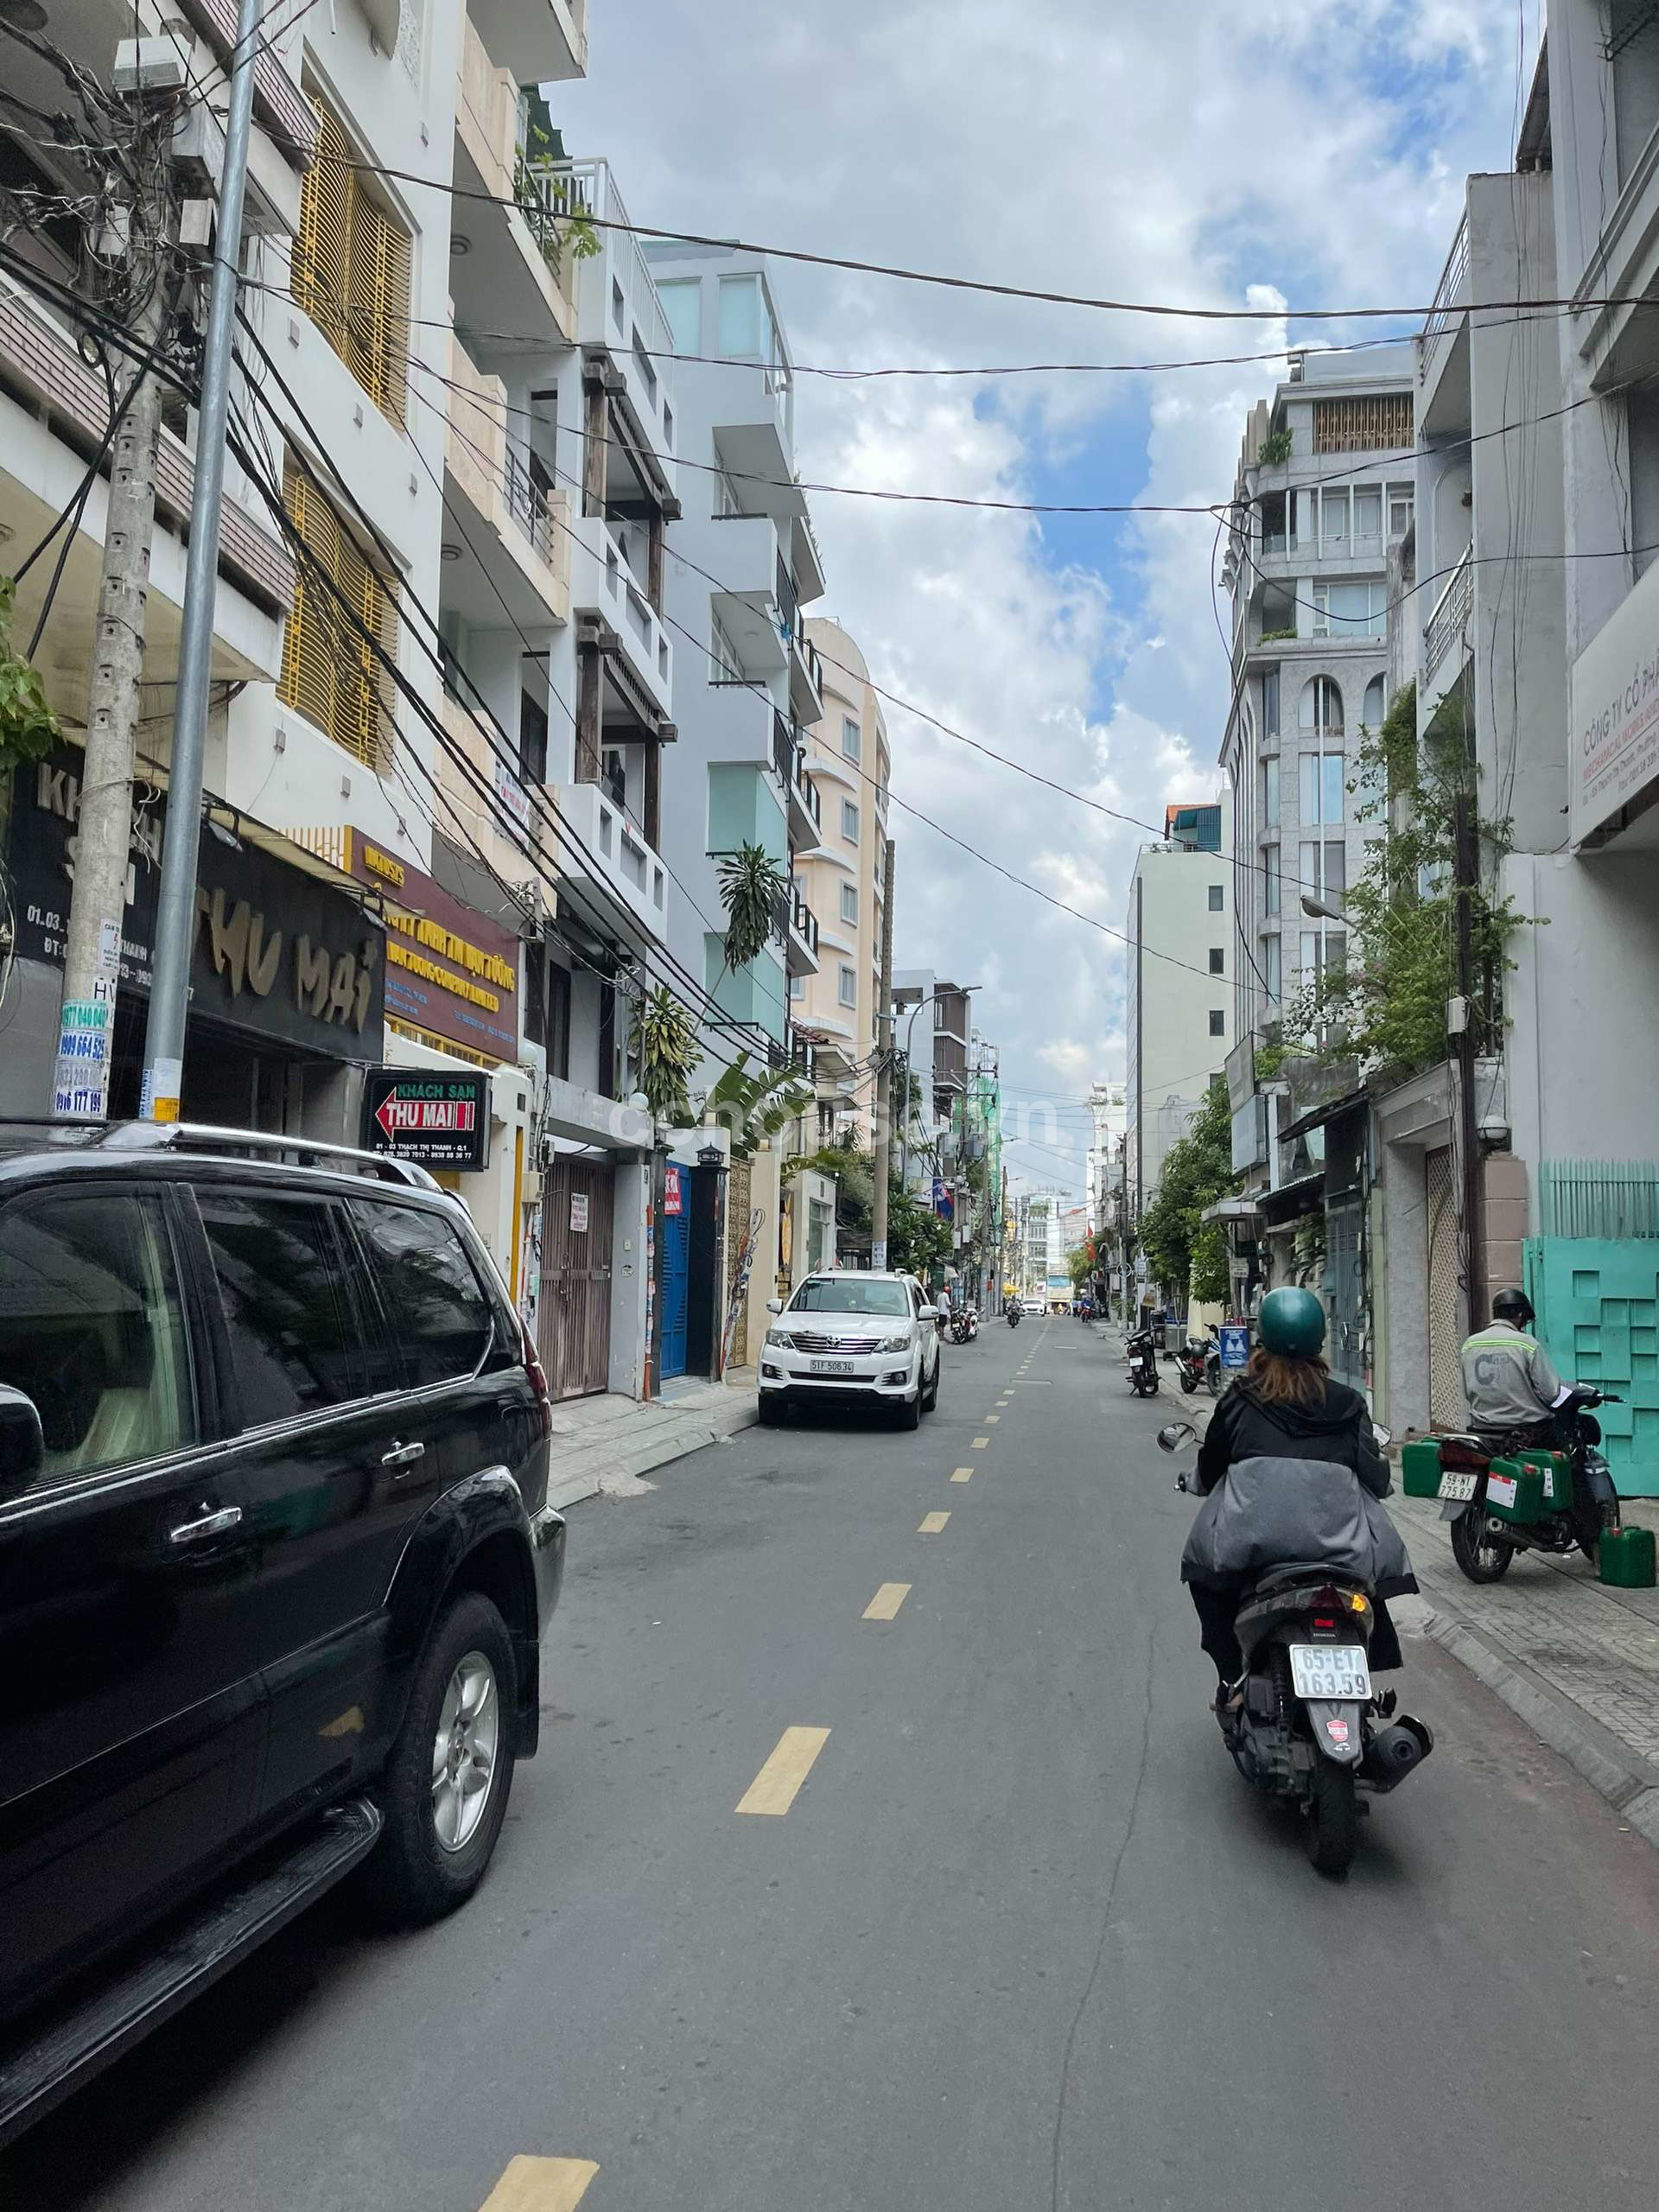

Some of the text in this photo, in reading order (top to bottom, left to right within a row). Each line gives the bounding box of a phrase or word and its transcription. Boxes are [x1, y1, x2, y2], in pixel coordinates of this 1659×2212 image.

[1611, 694, 1623, 728] TY
[74, 1090, 88, 1112] 177
[397, 1082, 475, 1102] KHÁCH SẠN
[386, 1103, 453, 1128] THU MAI
[811, 1361, 824, 1370] 51F
[1302, 1649, 1354, 1670] 65-E1
[1300, 1673, 1366, 1695] 163.59
